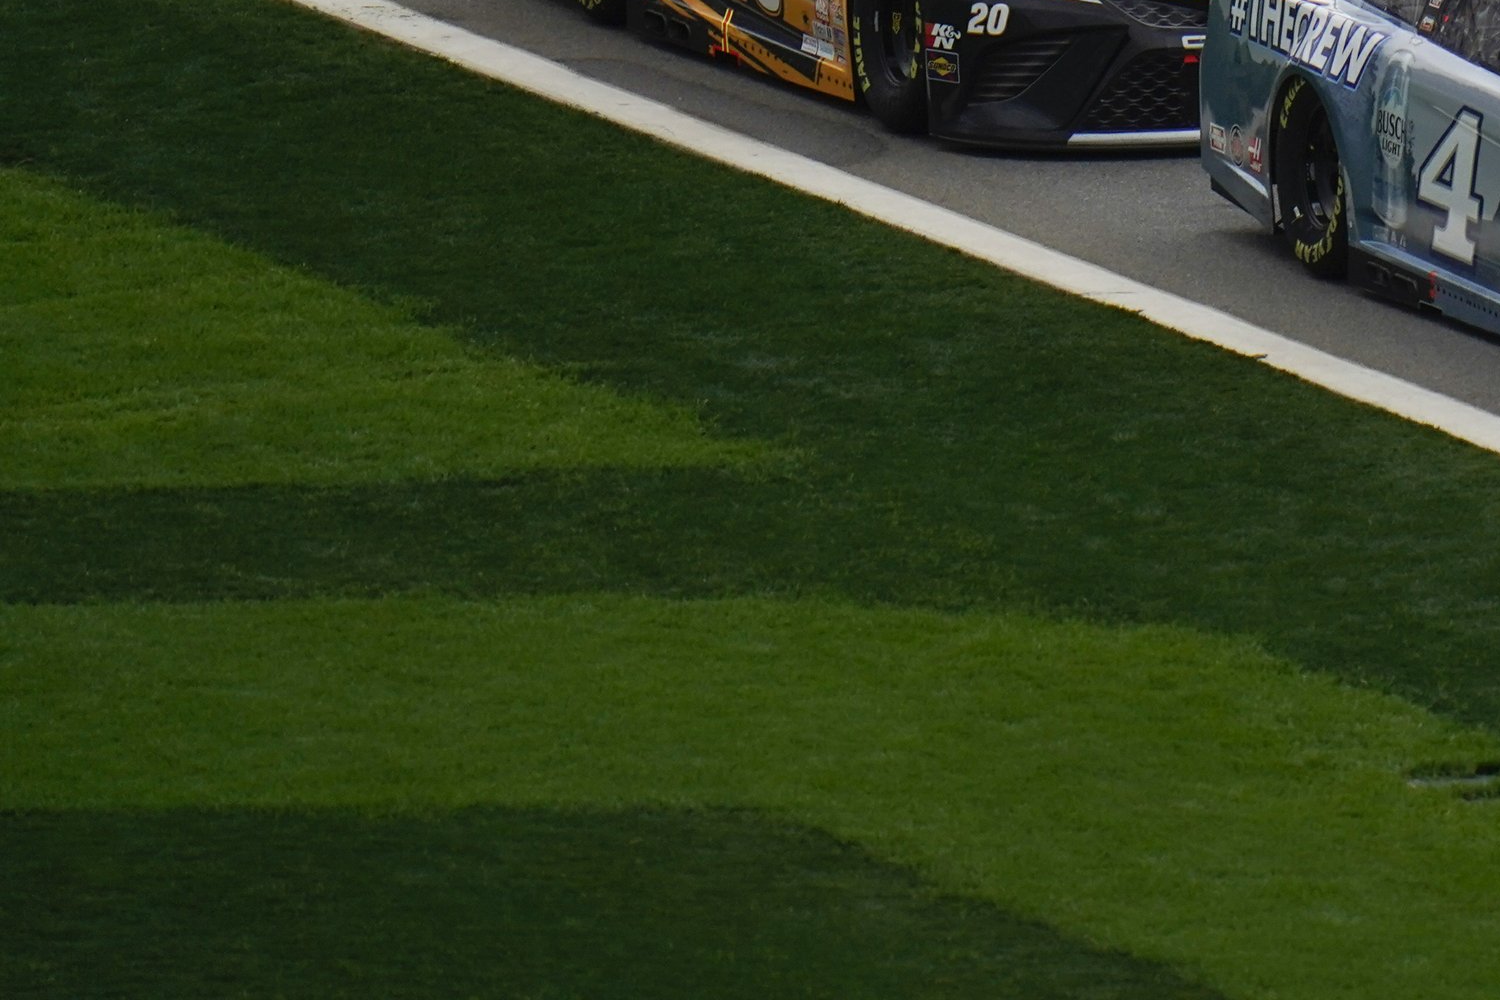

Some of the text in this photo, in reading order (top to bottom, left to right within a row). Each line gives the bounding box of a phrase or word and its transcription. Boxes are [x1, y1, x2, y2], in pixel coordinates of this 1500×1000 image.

[966, 2, 1011, 37] 20
[852, 15, 871, 94] EAGLE
[927, 59, 957, 73] SUNOCO
[1376, 109, 1407, 144] BUSCH
[1382, 137, 1401, 159] LIGHT
[1418, 104, 1484, 266] 4
